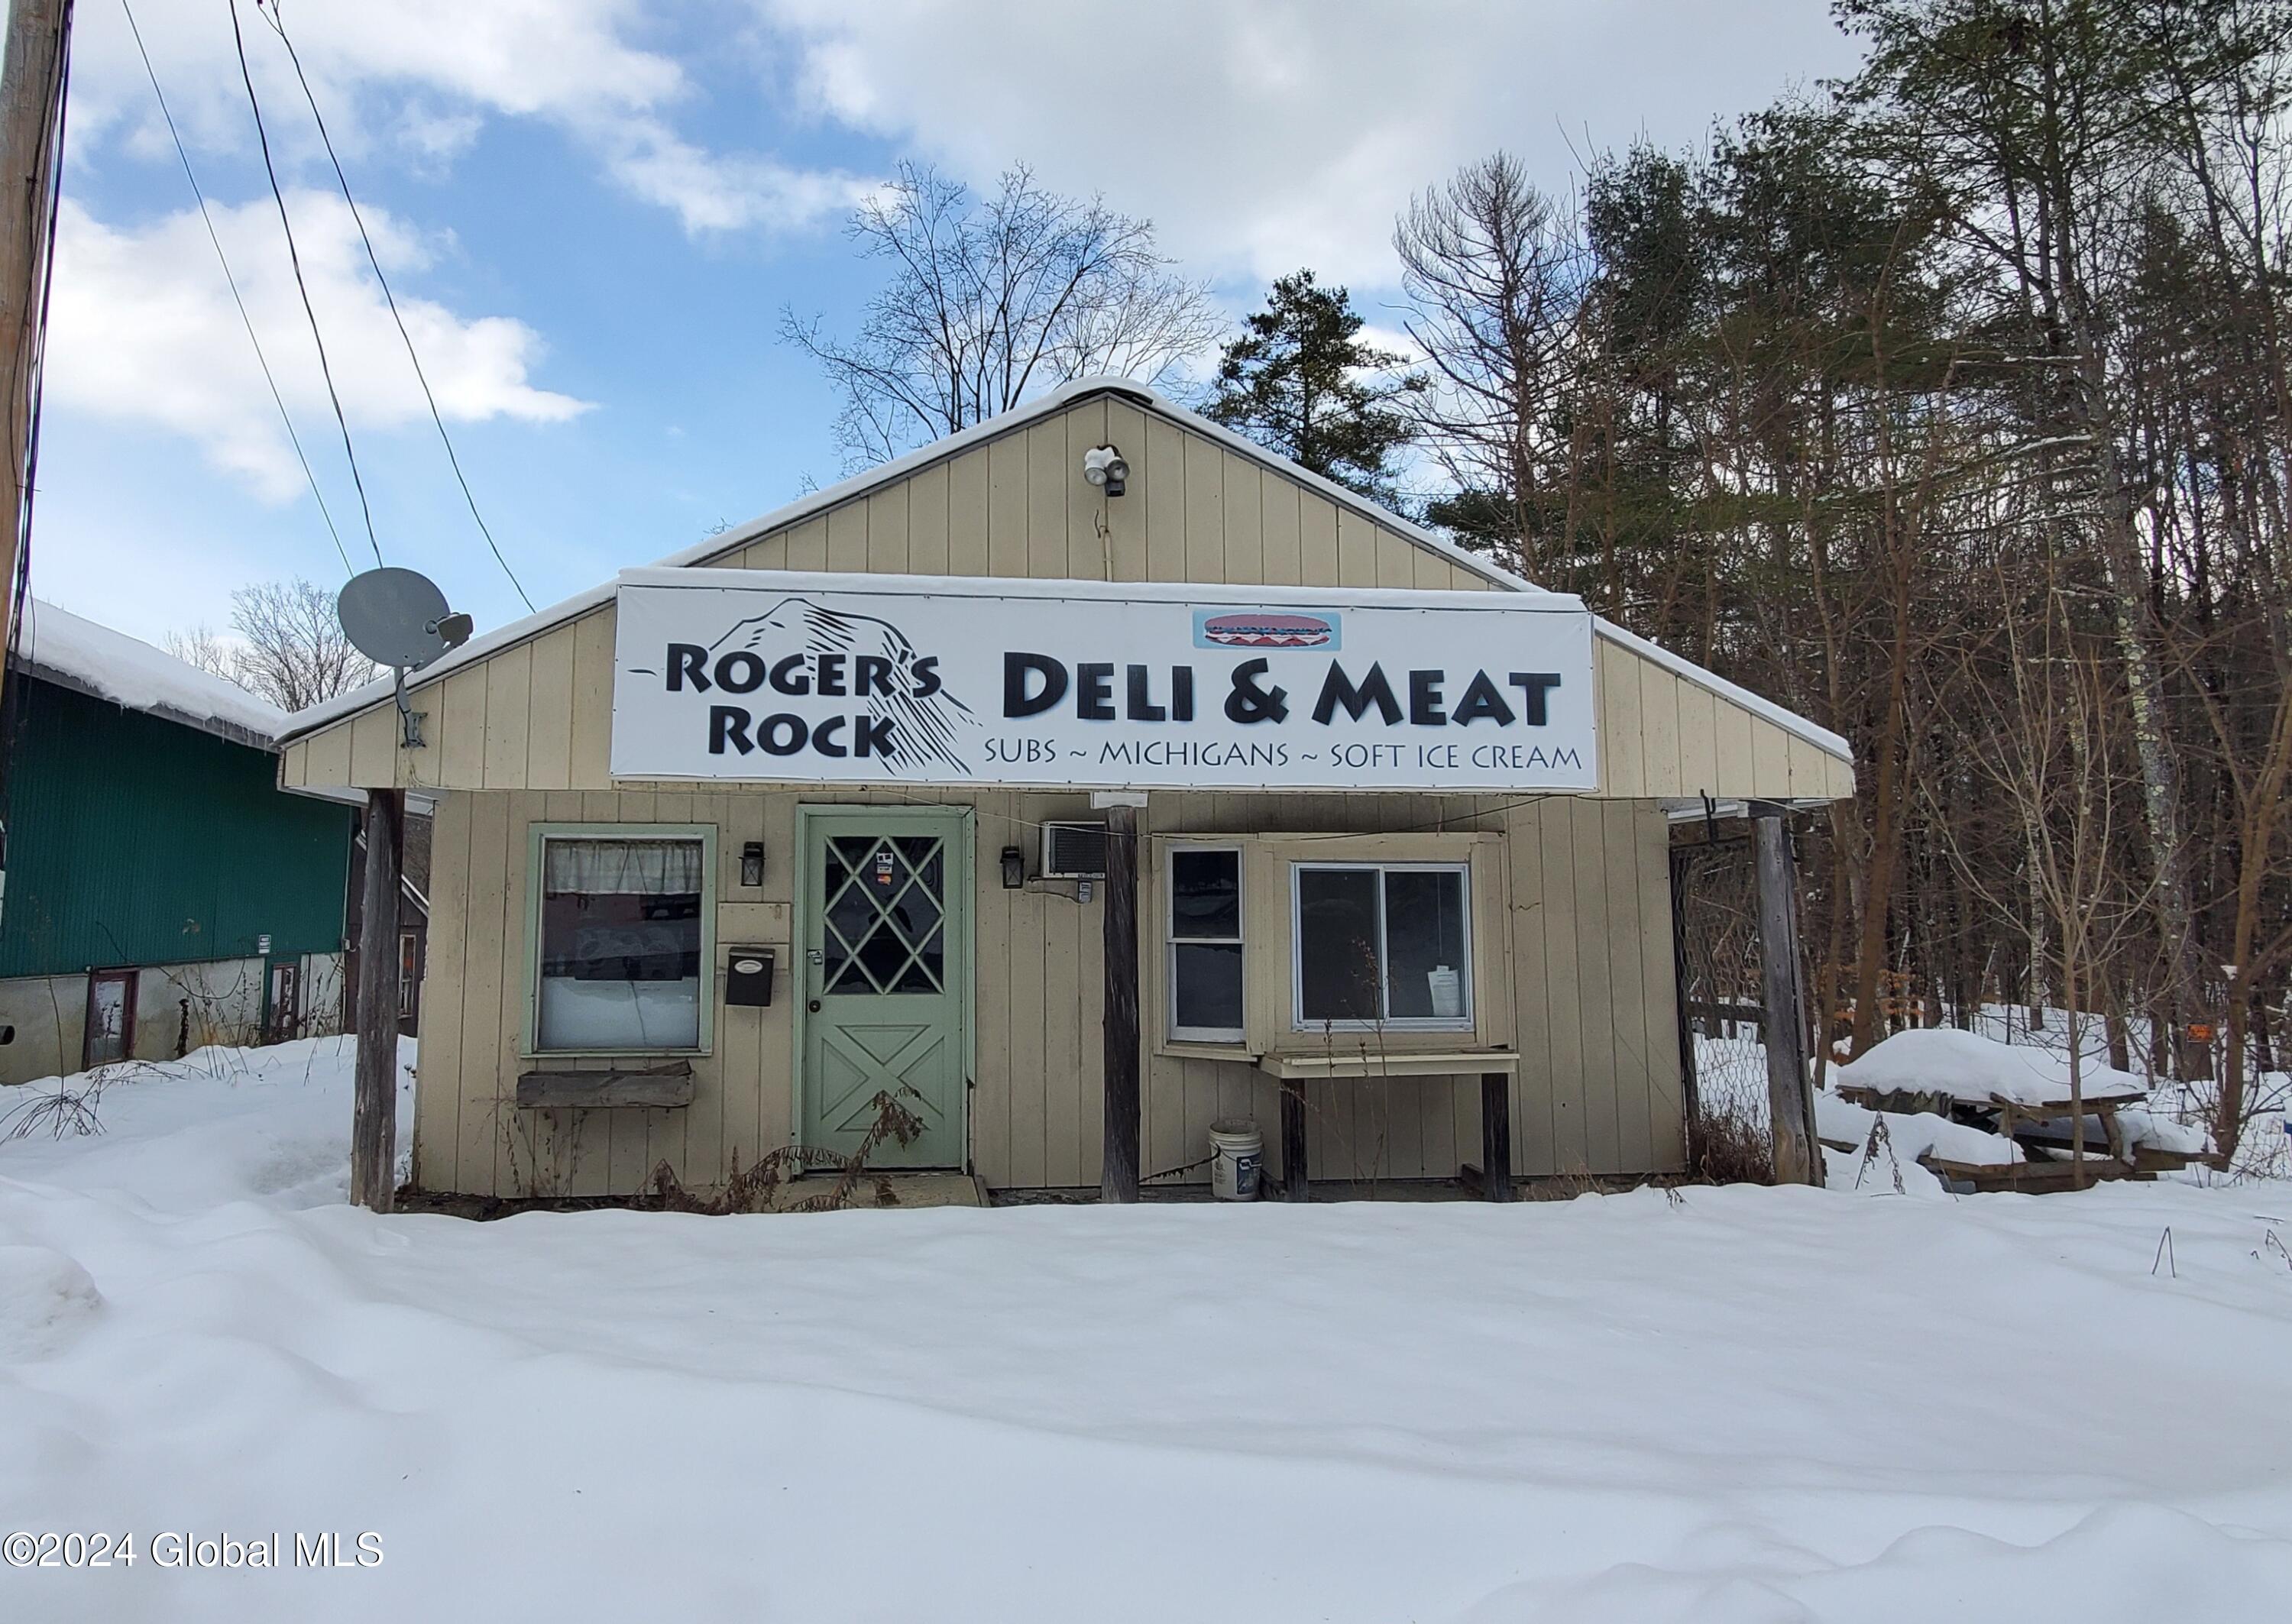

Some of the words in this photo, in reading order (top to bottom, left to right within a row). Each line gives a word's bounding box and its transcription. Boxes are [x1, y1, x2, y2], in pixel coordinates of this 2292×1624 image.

[1003, 652, 1194, 722] DELI
[1224, 657, 1290, 725] &
[1311, 658, 1562, 728] MEAT
[708, 705, 897, 759] ROCK
[984, 738, 1056, 763] SUBS
[1099, 741, 1289, 767] MICHIGANS
[1331, 743, 1406, 768] SOFT
[1419, 745, 1459, 768] ICE
[1472, 745, 1582, 770] CREAM
